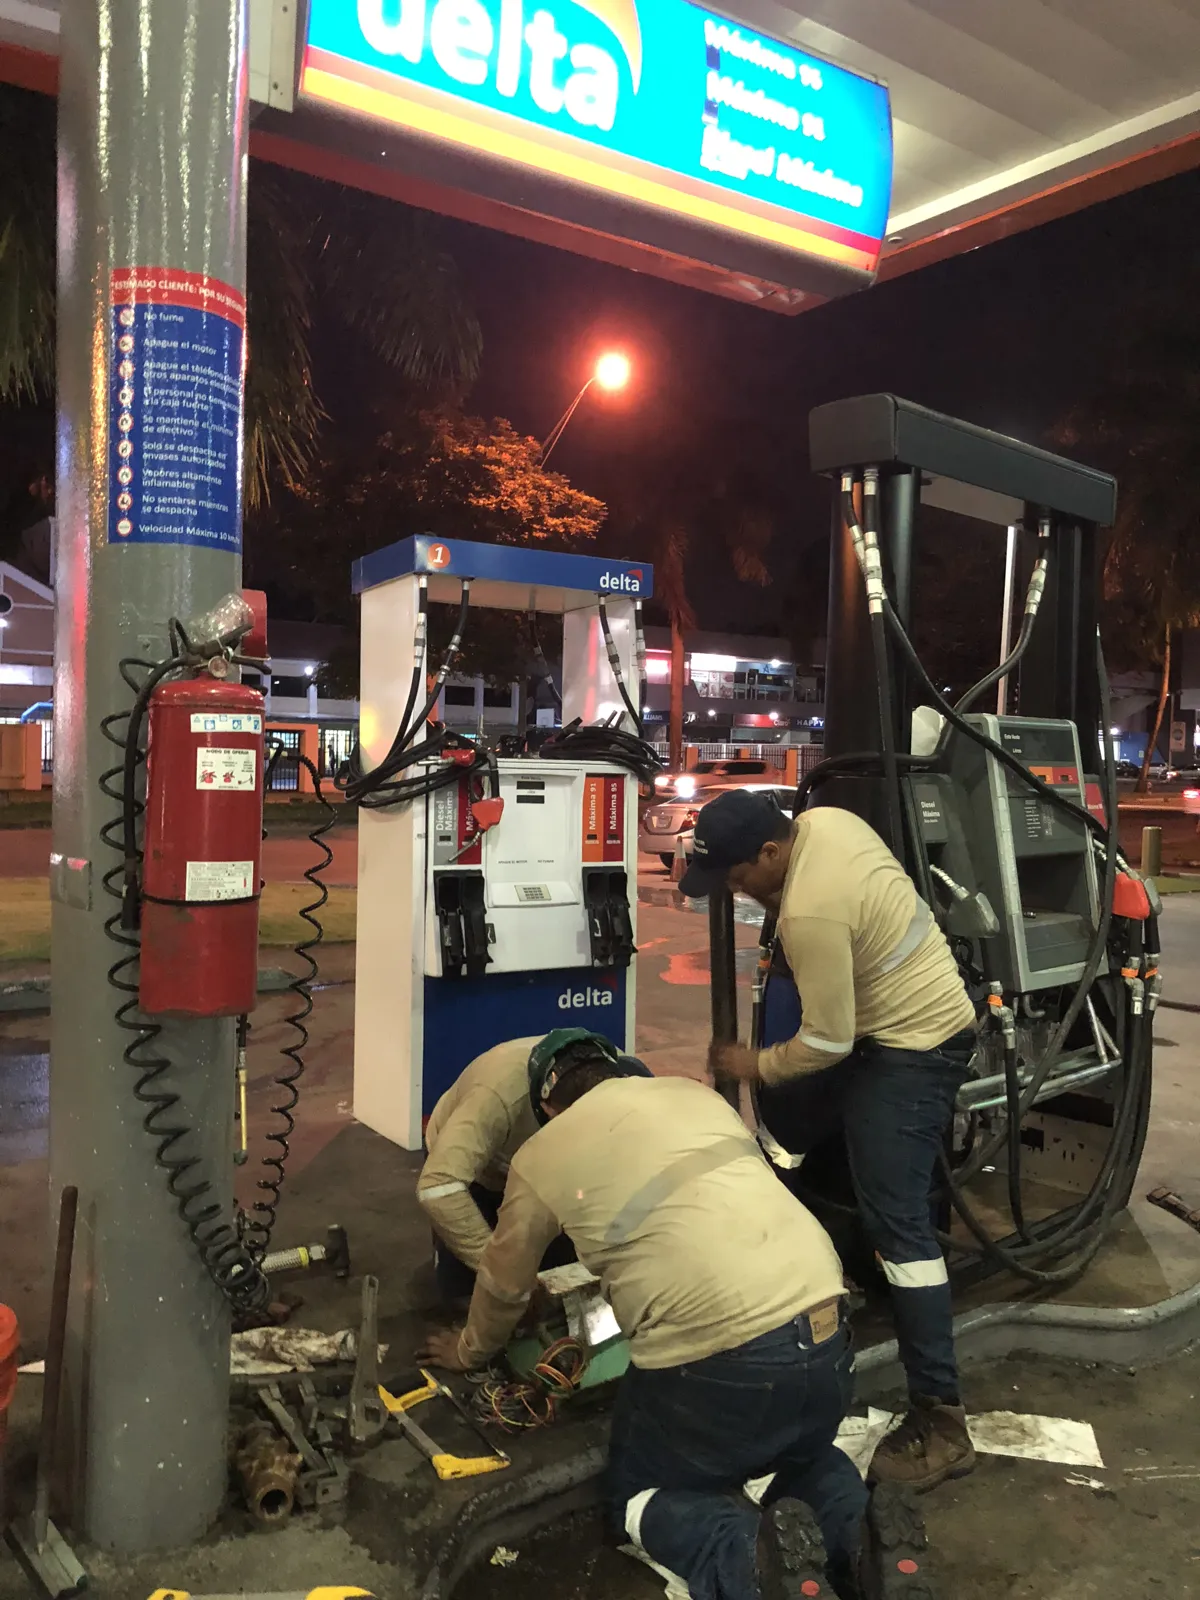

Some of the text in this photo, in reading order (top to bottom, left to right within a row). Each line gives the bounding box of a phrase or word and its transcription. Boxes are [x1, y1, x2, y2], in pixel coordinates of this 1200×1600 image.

[144, 312, 184, 323] No fume
[143, 338, 218, 356] Apague el motor
[143, 360, 179, 370] Apague
[143, 371, 209, 386] otros aparatos
[153, 388, 194, 399] personal
[161, 398, 180, 408] caja
[182, 399, 209, 411] fuerte
[142, 414, 154, 424] Se
[156, 416, 200, 427] mantiene
[142, 424, 194, 436] de efectivo
[164, 442, 175, 450] se
[177, 443, 217, 458] despacha
[142, 453, 227, 470] envases autorizados
[142, 479, 196, 490] inflamables
[181, 471, 222, 486] altamente
[142, 494, 229, 513] No sentarse mientras
[142, 505, 198, 516] se despacha
[139, 524, 184, 534] Velocidad
[186, 526, 218, 540] Máxima
[433, 546, 444, 564] 1
[599, 571, 640, 592] delta
[796, 719, 824, 727] HAPPY
[589, 783, 597, 792] 91
[610, 782, 618, 792] 95
[435, 800, 444, 831] Diesel
[444, 791, 453, 831] Máxima
[588, 794, 597, 830] Máxima
[609, 794, 617, 830] Máxima
[558, 986, 612, 1009] delta
